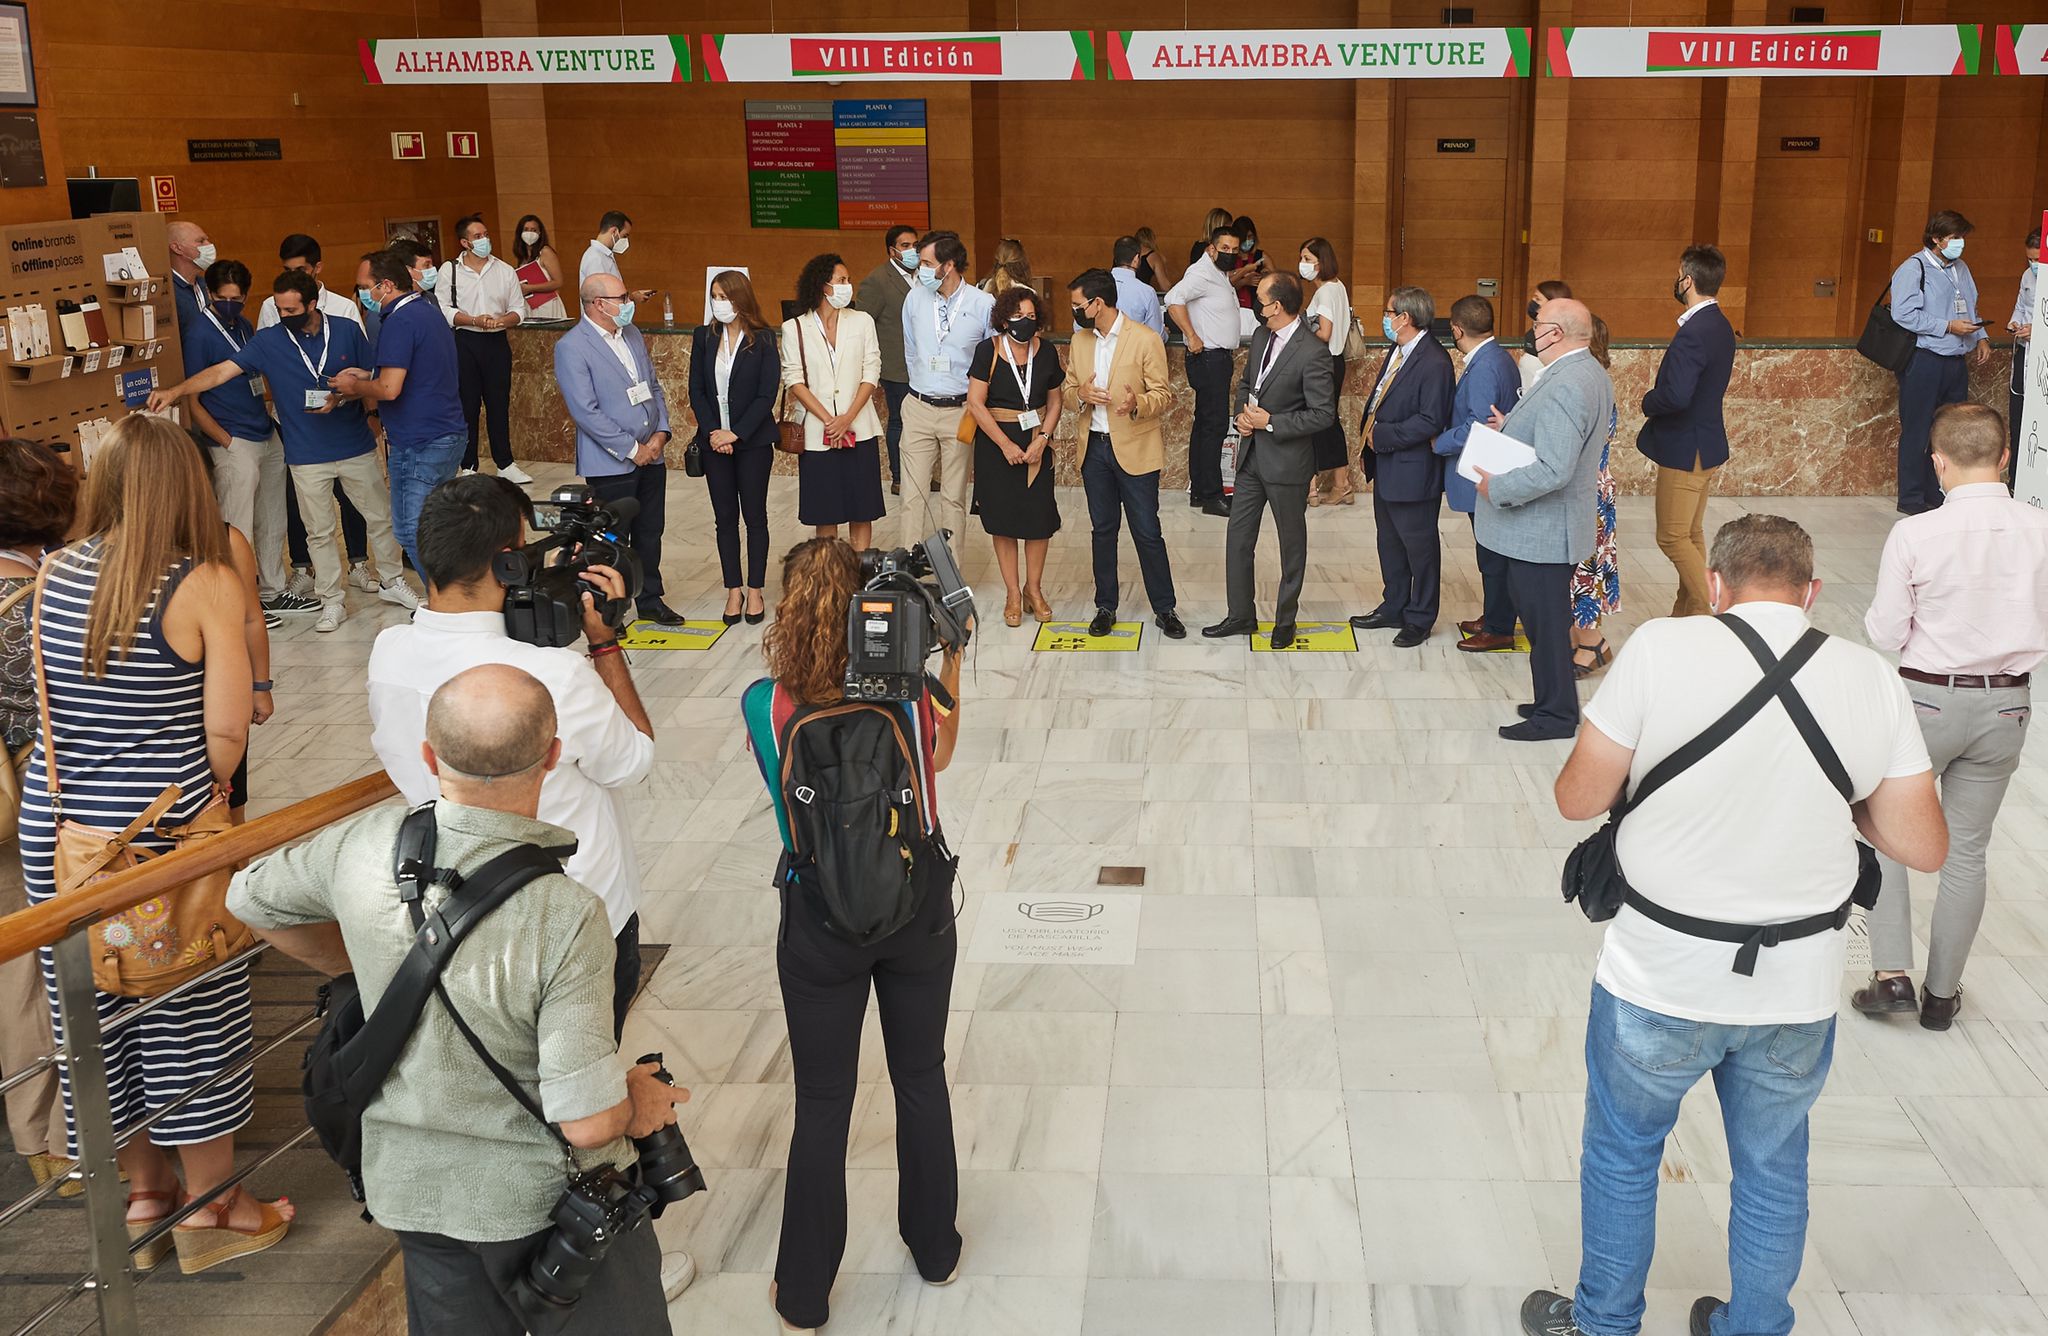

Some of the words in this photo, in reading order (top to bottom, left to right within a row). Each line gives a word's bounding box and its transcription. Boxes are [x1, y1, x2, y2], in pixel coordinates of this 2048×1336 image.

[395, 50, 534, 72] ALHAMBRA
[536, 49, 655, 71] VENTURE
[819, 47, 870, 67] VIII
[883, 46, 974, 67] Edición
[1152, 44, 1332, 67] ALHAMBRA
[1337, 42, 1485, 66] VENTURE
[1680, 41, 1736, 62] VIII
[1751, 40, 1848, 62] Edición
[12, 237, 44, 252] Online
[44, 234, 76, 248] brands
[12, 261, 22, 274] in
[22, 256, 54, 272] Offline
[54, 254, 84, 270] places
